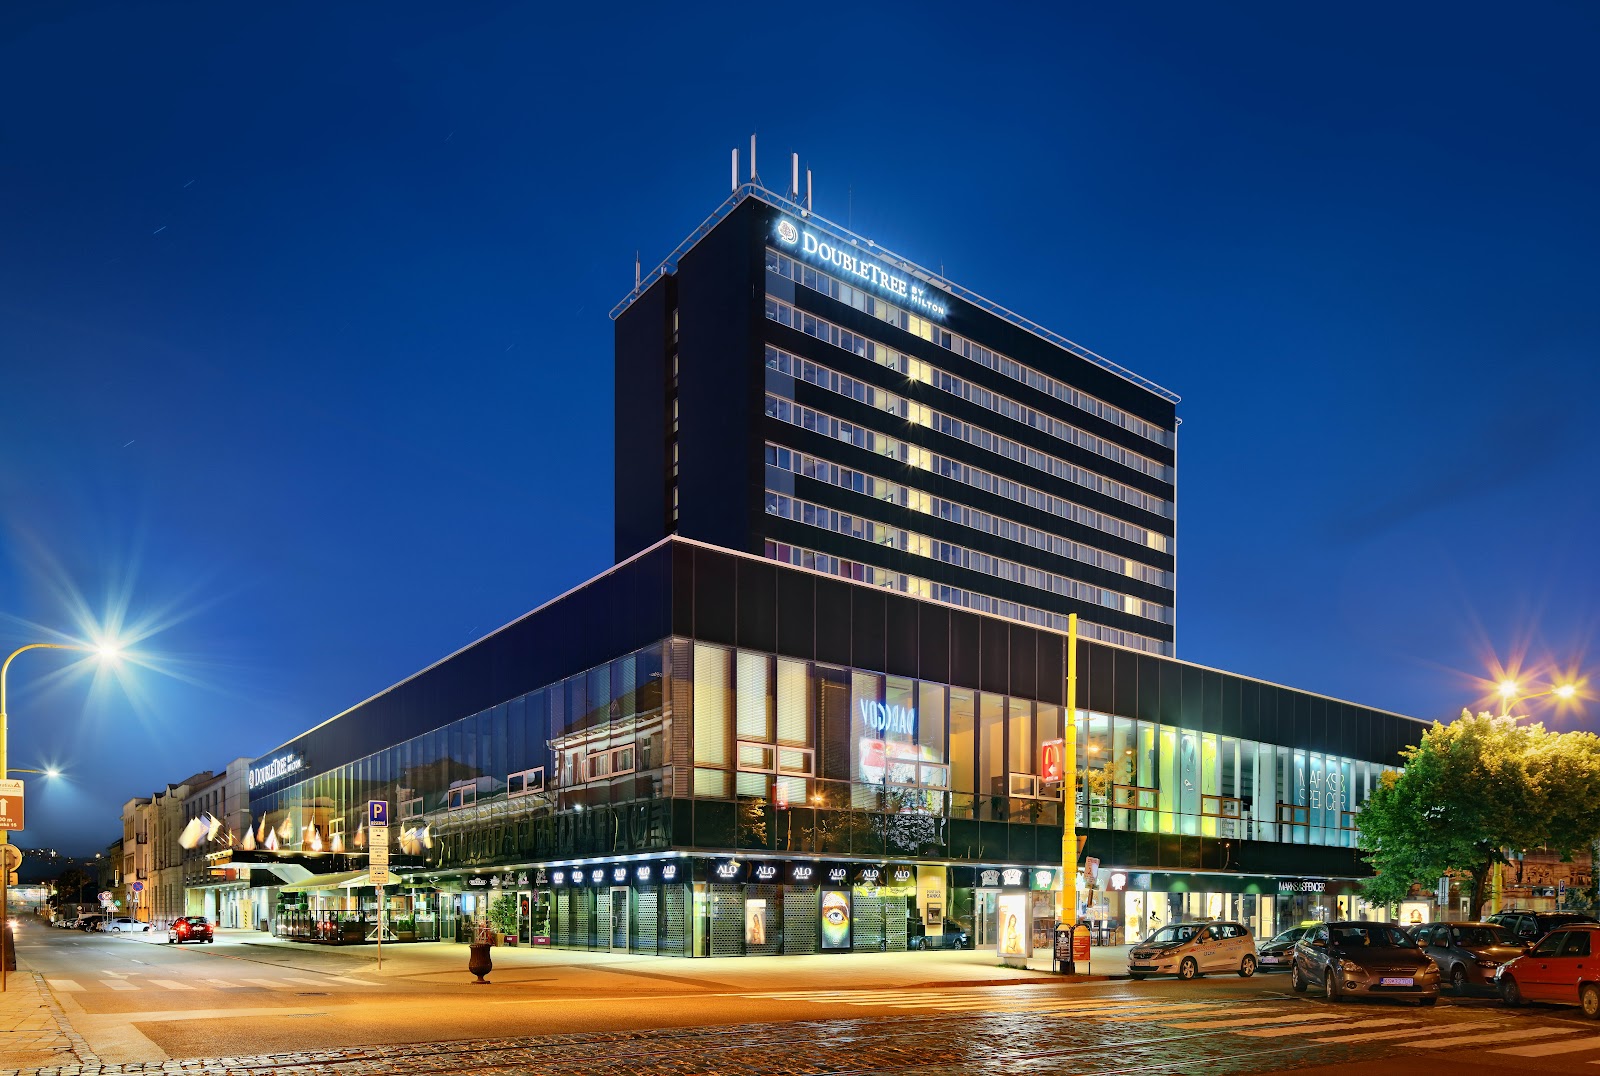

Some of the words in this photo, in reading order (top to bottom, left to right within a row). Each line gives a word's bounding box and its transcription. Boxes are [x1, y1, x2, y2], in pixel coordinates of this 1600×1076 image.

[911, 285, 924, 297] BY
[911, 294, 945, 315] HILTON
[717, 865, 737, 874] ALO
[756, 867, 775, 875] ALO
[793, 868, 811, 876] ALO
[829, 869, 847, 877] ALO
